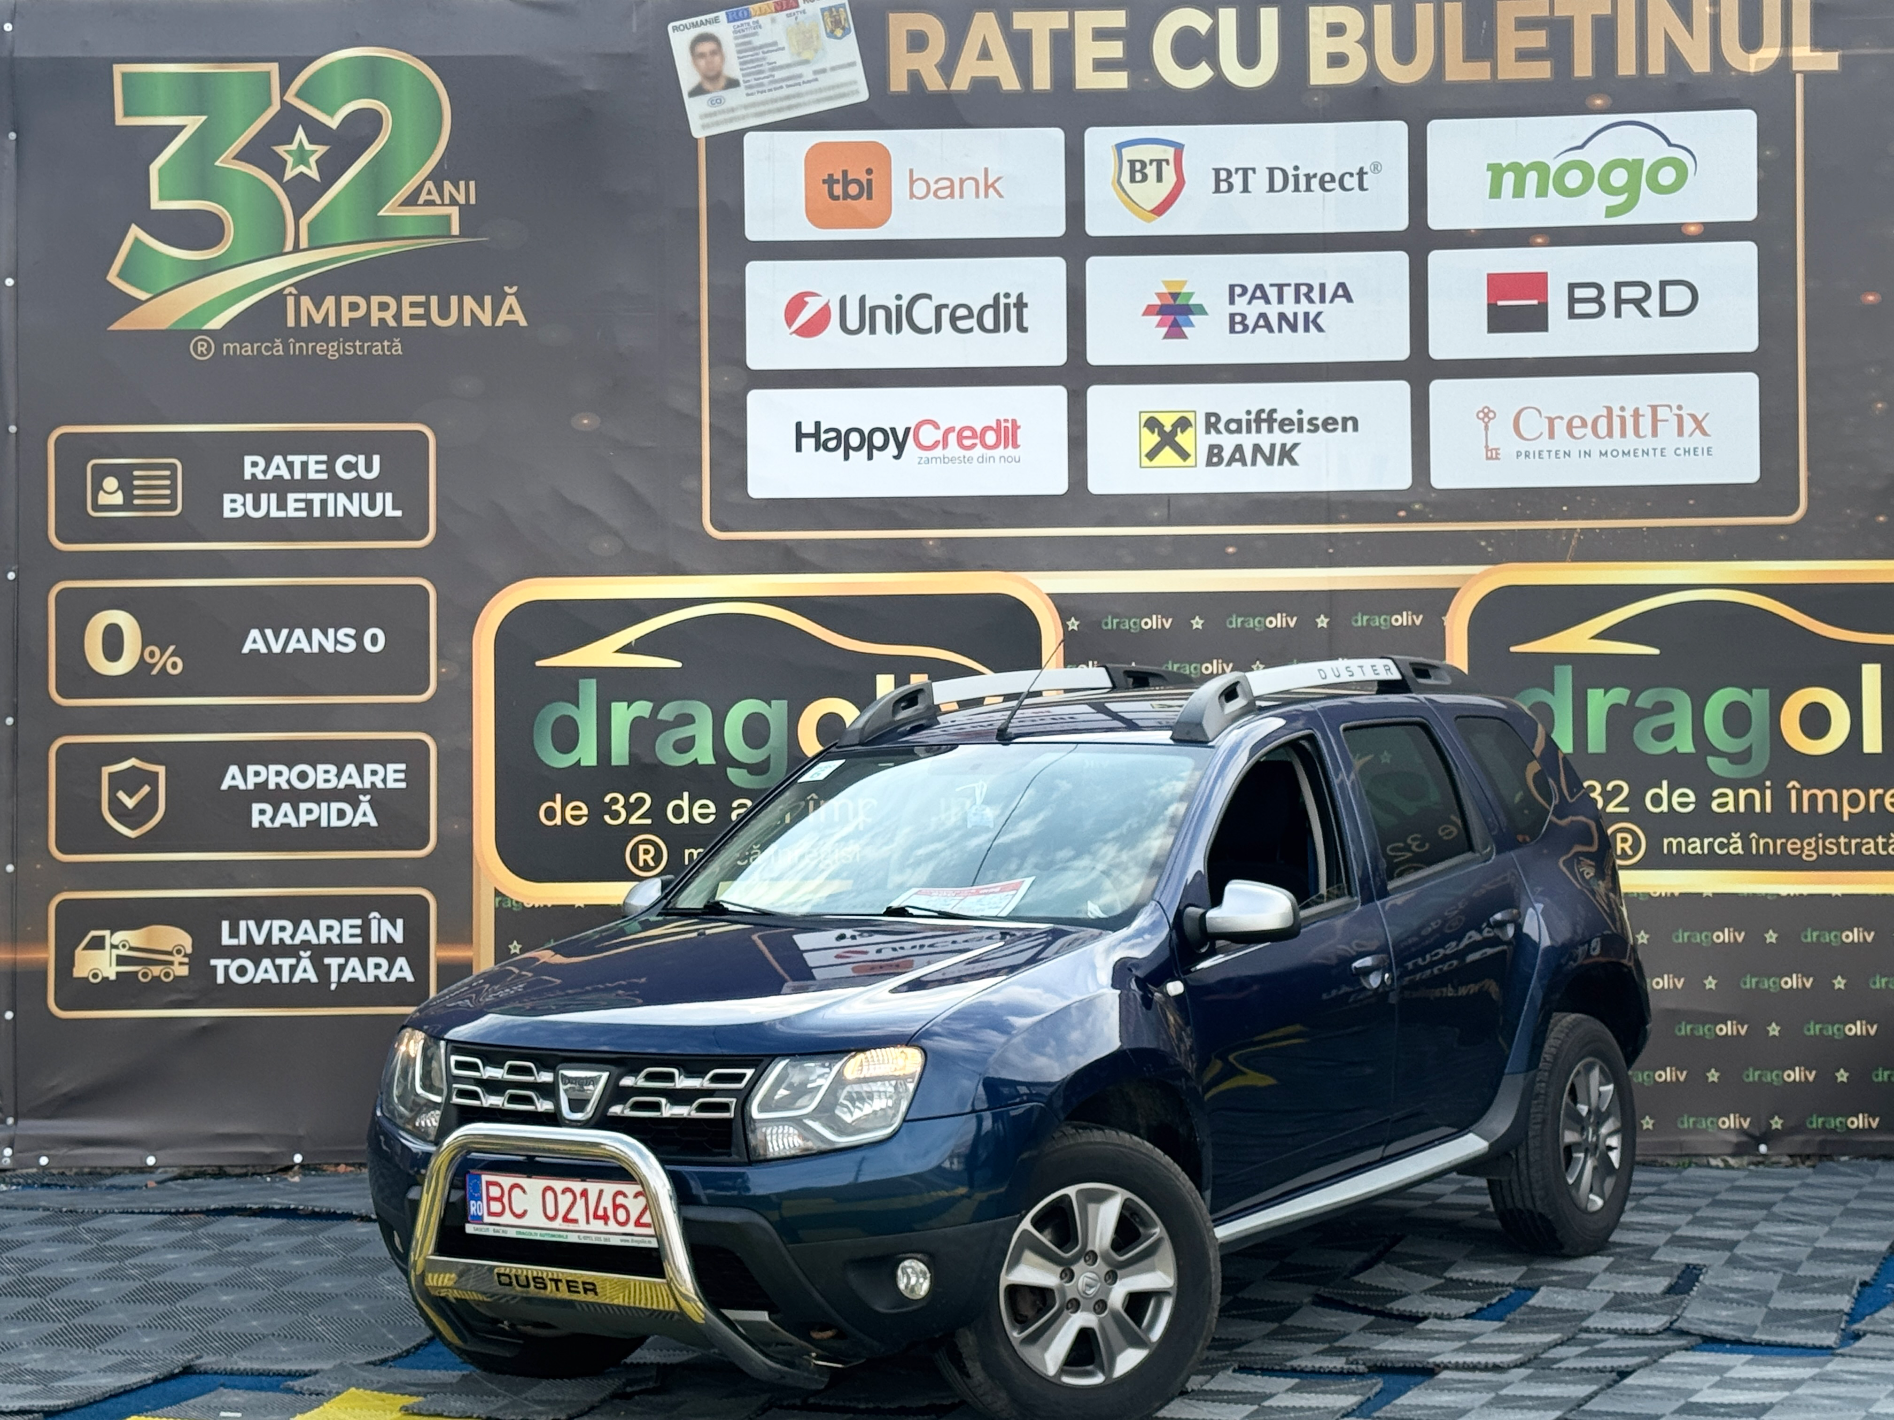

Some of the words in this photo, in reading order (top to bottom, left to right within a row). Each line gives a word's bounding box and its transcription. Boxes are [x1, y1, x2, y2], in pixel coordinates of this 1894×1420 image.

[672, 15, 721, 33] ROUMANIE
[888, 11, 1129, 92] RATE
[1152, 7, 1280, 89] CU
[1308, 0, 1840, 85] BULETINUL
[106, 46, 460, 301] 32
[416, 180, 476, 205] ANI
[1127, 158, 1170, 183] BT
[1212, 167, 1256, 194] BT
[822, 167, 874, 201] tbi
[908, 167, 1005, 200] bank
[1486, 156, 1689, 219] mogo
[1228, 281, 1355, 305] PATRIA
[1567, 279, 1700, 320] BRD
[285, 286, 528, 328] ÎMPREUNĂ
[838, 291, 1029, 336] UniCredit
[1228, 310, 1326, 335] BANK
[222, 339, 284, 357] marcă
[288, 338, 403, 360] înregistrată
[1204, 409, 1359, 435] Raiffeisen
[1512, 404, 1712, 442] CreditFix
[795, 418, 1021, 461] HappyCredit
[917, 454, 974, 465] zambeste
[977, 453, 996, 464] din
[999, 455, 1021, 464] nou
[1204, 442, 1302, 468] BANK
[1516, 449, 1571, 461] PRIETEN
[1578, 449, 1592, 459] IN
[1599, 447, 1667, 459] MOMENTE
[1674, 446, 1714, 457] CHEIE
[243, 454, 328, 481] RATE
[334, 454, 381, 480] CU
[222, 491, 403, 519] BULETINUL
[1101, 612, 1173, 632] dragoliv
[1226, 612, 1298, 631] dragoliv
[1351, 611, 1424, 629] dragoliv
[240, 628, 357, 654] AVANS
[363, 627, 386, 653] 0
[1316, 663, 1394, 681] DUSTER
[219, 763, 407, 791] APROBARE
[538, 793, 589, 826] de
[603, 792, 652, 825] 32
[666, 791, 716, 823] de
[1583, 779, 1630, 813] 32
[1644, 779, 1696, 813] de
[1710, 780, 1772, 813] ani
[251, 794, 378, 828] RAPIDĂ
[1663, 833, 1744, 855] marcă
[221, 918, 362, 945] LIVRARE
[368, 911, 404, 943] ÎN
[1672, 927, 1745, 946] dragoliv
[1801, 927, 1875, 946] dragoliv
[210, 950, 318, 984] TOATĂ
[323, 956, 415, 990] ȚARA
[1650, 973, 1685, 990] oliv
[1740, 973, 1813, 993] dragoliv
[1675, 1020, 1749, 1040] dragoliv
[1803, 1019, 1878, 1039] dragoliv
[1628, 1066, 1688, 1086] agoliv
[1743, 1066, 1816, 1085] dragoliv
[1677, 1113, 1751, 1133] dragoliv
[1806, 1112, 1880, 1132] dragoliv
[469, 1200, 482, 1214] RO
[485, 1180, 528, 1219] BC
[541, 1186, 652, 1228] 021462
[496, 1272, 599, 1297] DUSTER
